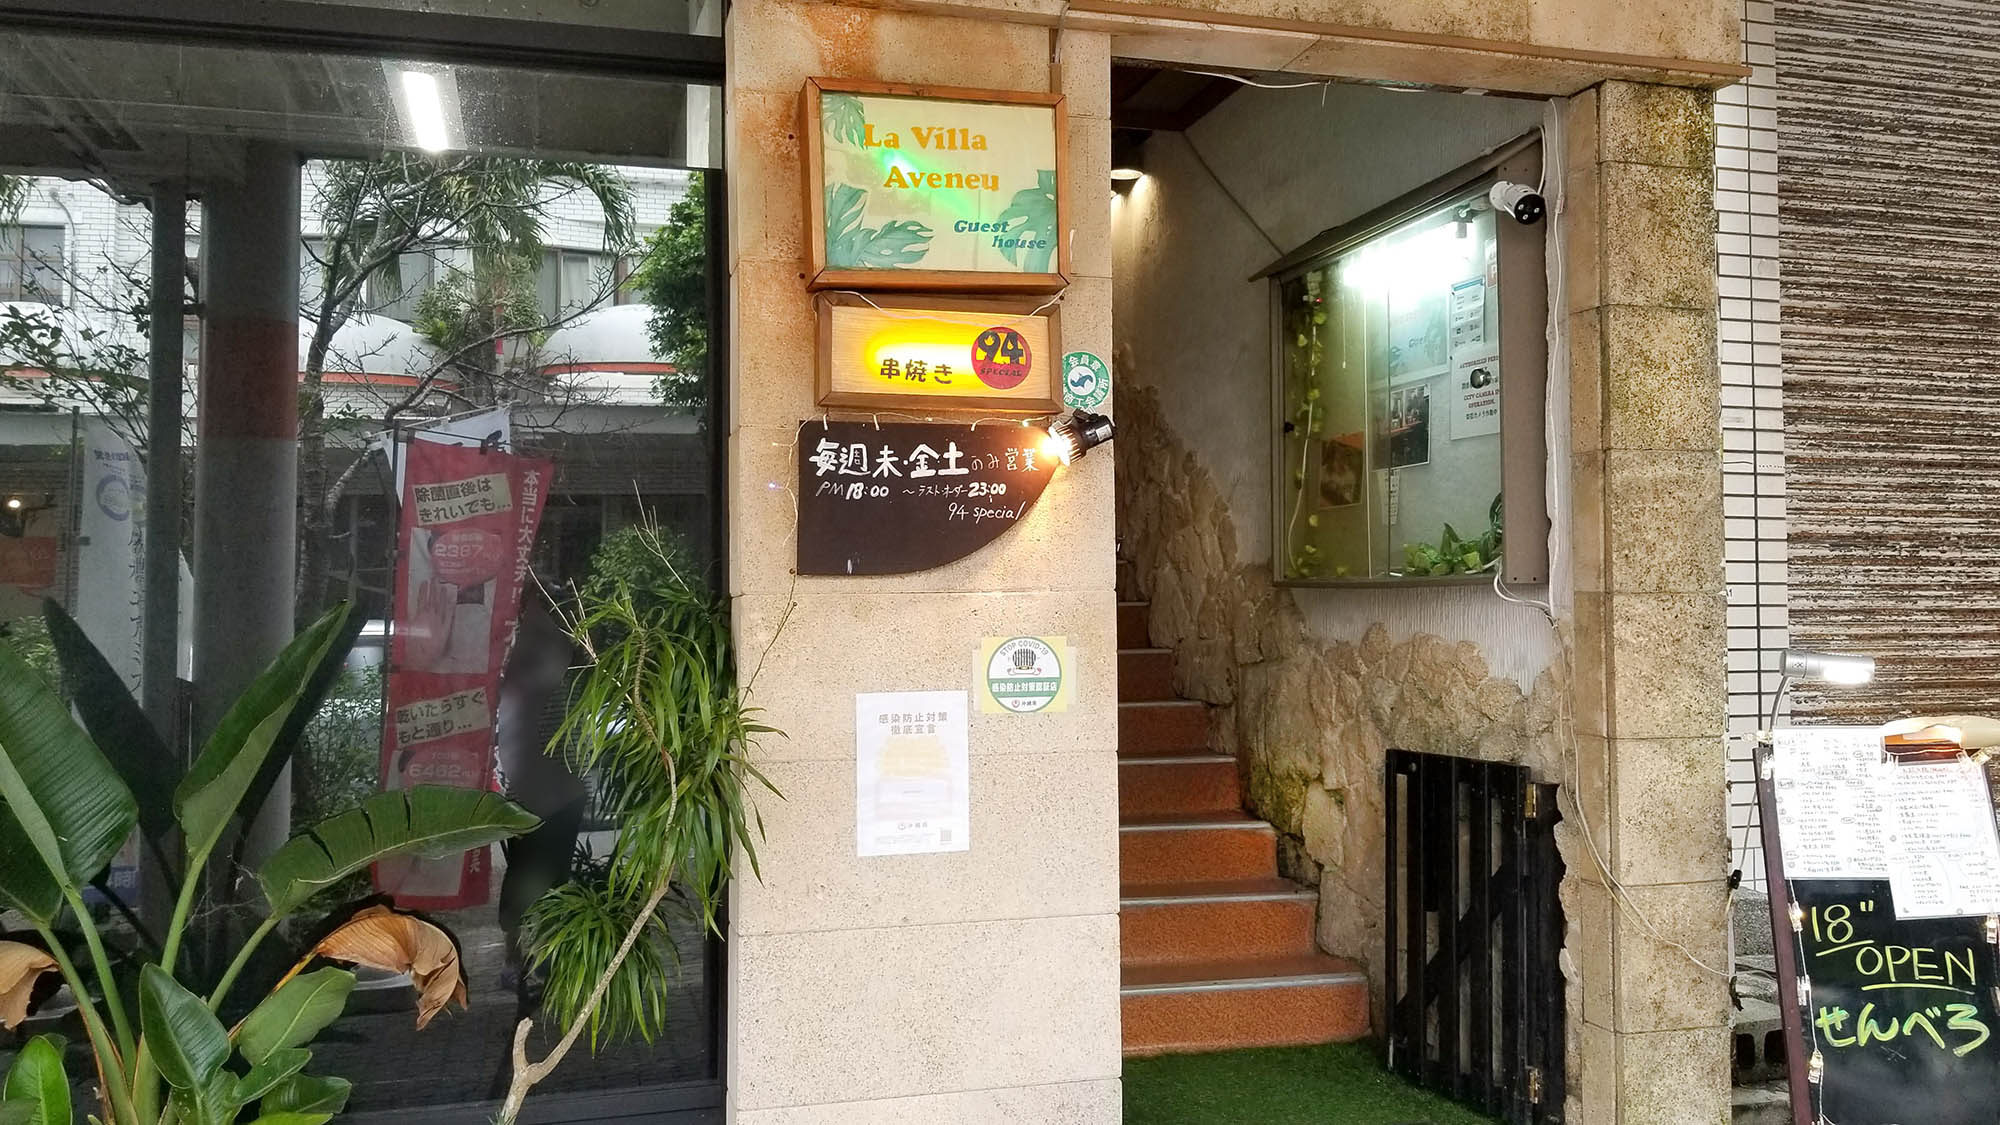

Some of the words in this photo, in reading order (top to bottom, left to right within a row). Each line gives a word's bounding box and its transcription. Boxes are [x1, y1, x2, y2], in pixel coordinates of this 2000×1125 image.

[863, 124, 900, 149] La
[911, 126, 988, 151] Villa
[883, 165, 1000, 192] Aveneu
[953, 219, 1011, 233] Guest
[991, 234, 1047, 249] house
[977, 330, 1024, 365] 94
[879, 357, 953, 385] 串焼き
[979, 367, 1023, 377] SPECIAL
[414, 477, 493, 504] 除菌直後は
[816, 481, 844, 497] PM
[845, 481, 890, 500] 18:00
[948, 502, 969, 520] 94
[973, 501, 1027, 524] special
[999, 642, 1017, 657] STOP
[397, 691, 485, 724] 乾いたらすぐ
[1855, 945, 1976, 986] OPEN
[1815, 1002, 1990, 1057] せんべろ
